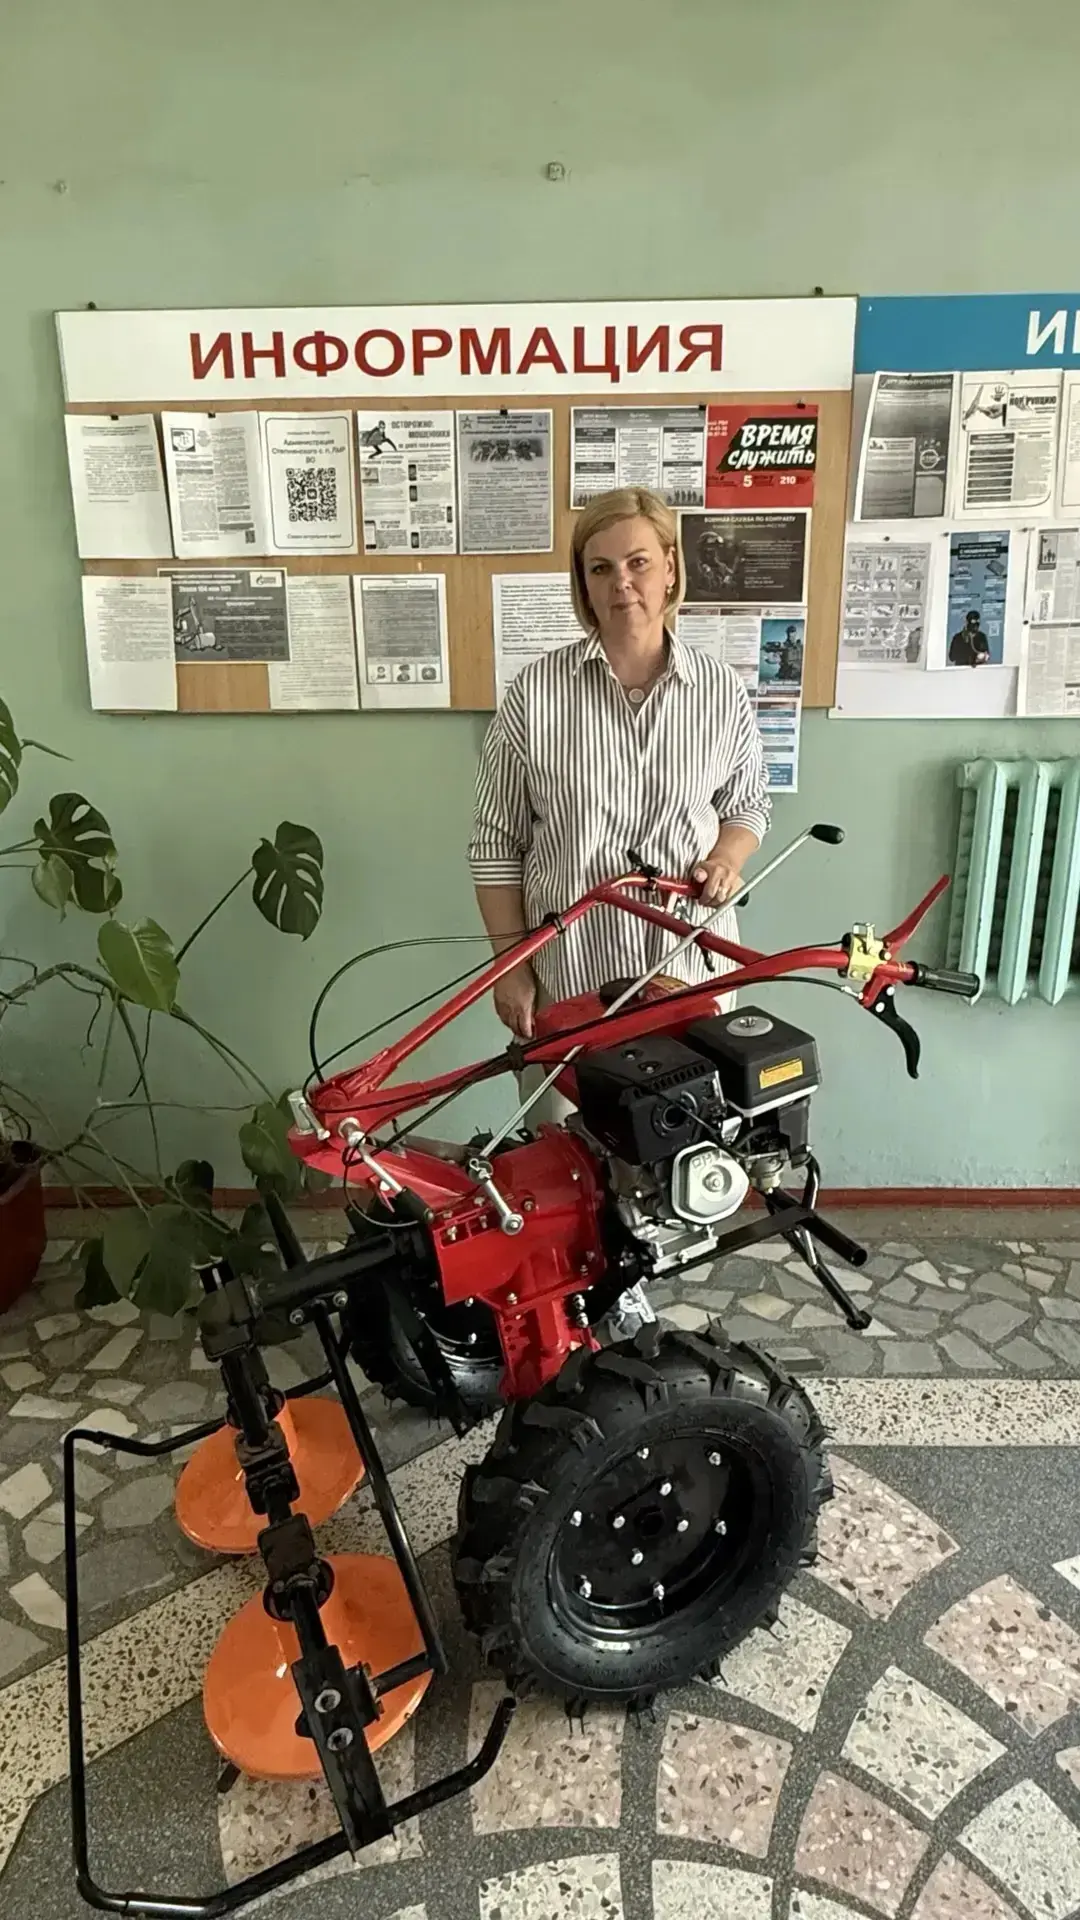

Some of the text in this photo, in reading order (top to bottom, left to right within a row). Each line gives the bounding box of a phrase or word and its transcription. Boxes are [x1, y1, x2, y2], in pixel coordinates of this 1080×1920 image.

[1026, 309, 1080, 355] И
[189, 324, 723, 384] ИНФОРМАЦИЯ
[740, 424, 815, 448] ВРЕМЯ
[743, 475, 753, 487] 5
[780, 476, 796, 485] 210
